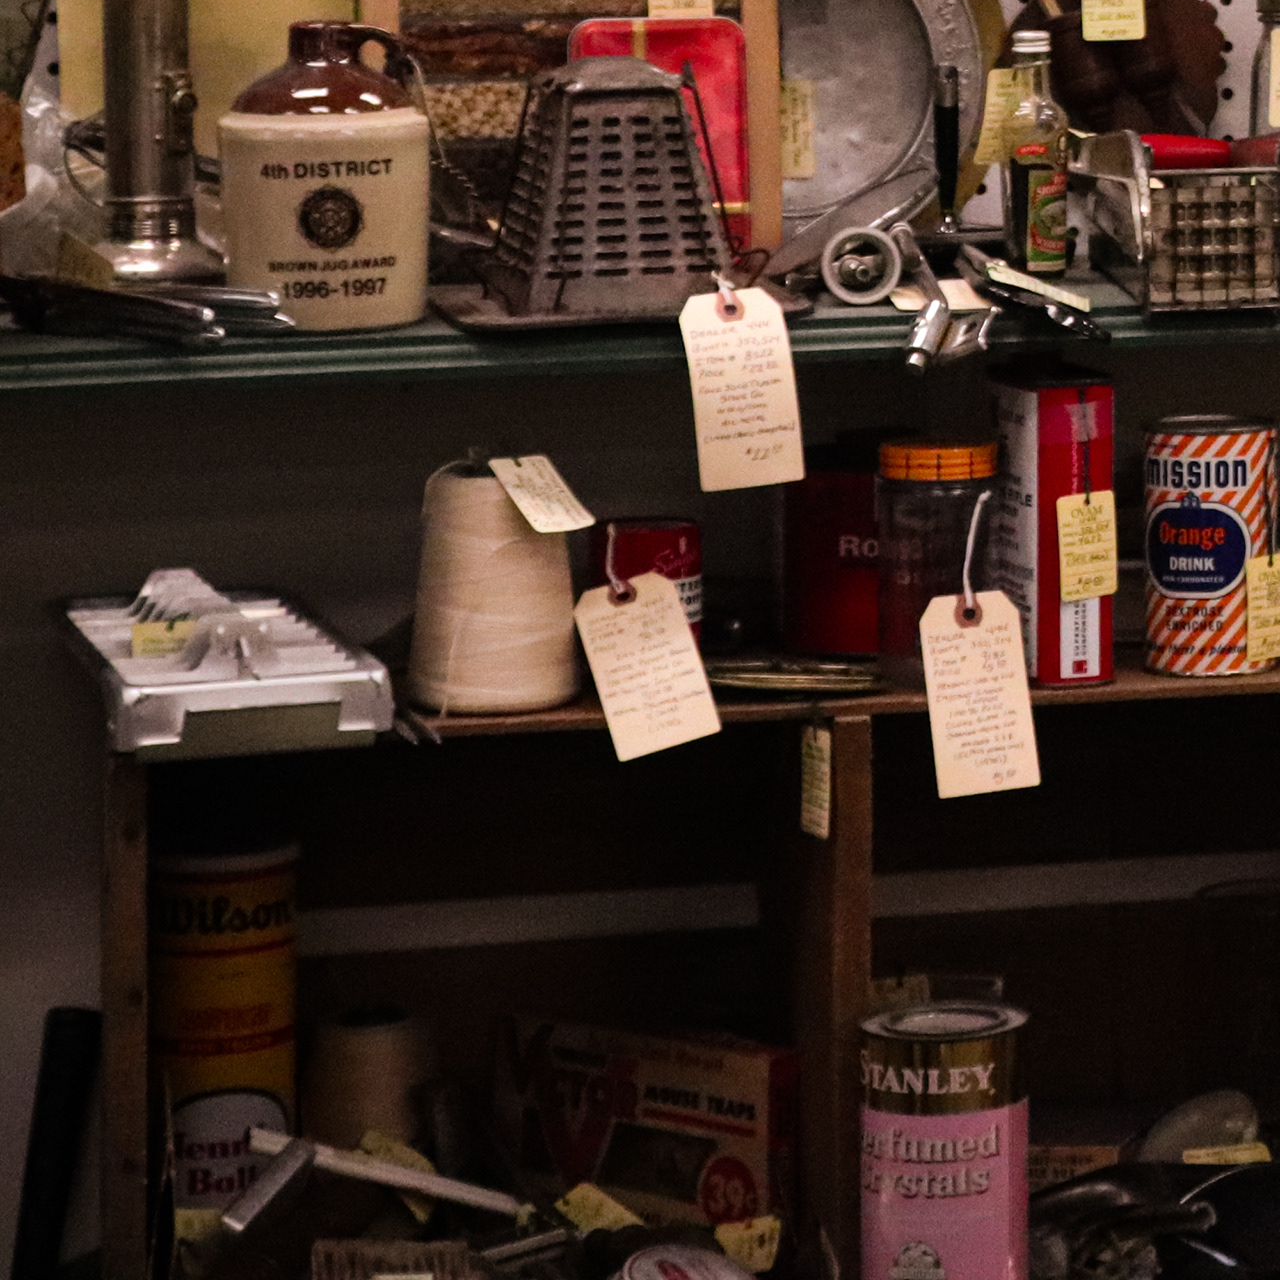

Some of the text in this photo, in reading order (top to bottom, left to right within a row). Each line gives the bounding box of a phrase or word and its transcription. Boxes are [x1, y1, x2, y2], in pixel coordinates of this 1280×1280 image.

[260, 158, 392, 180] 4th DISTRICT
[268, 256, 396, 273] BROWN JUG AWARD
[283, 277, 386, 299] 1996-1997
[1159, 521, 1227, 551] Orange
[1170, 556, 1216, 571] DRINK
[1166, 605, 1224, 617] DEXTROSE
[1166, 621, 1224, 631] ENRICHED
[643, 1085, 756, 1120] MOUSE TRAPS
[863, 1122, 1001, 1163] erfumed
